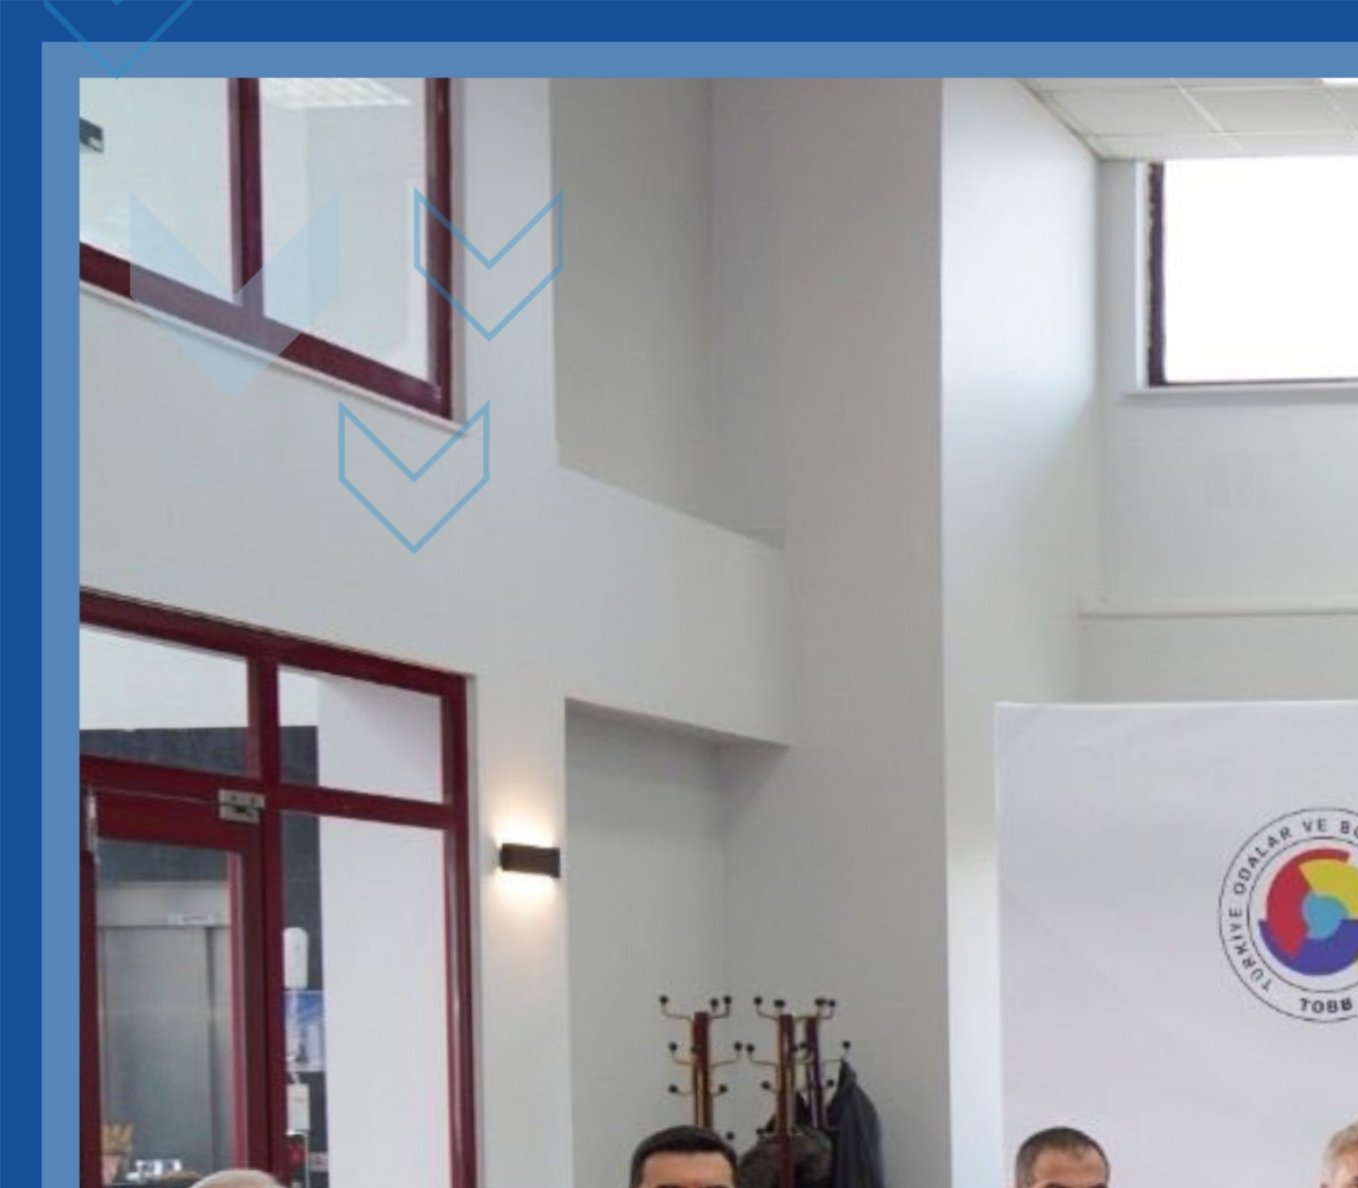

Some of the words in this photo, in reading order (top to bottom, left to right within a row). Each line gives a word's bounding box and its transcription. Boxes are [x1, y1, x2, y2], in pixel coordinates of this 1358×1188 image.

[1233, 826, 1294, 896] ODALAR
[1302, 818, 1328, 833] VE
[1298, 997, 1354, 1014] TOBB
